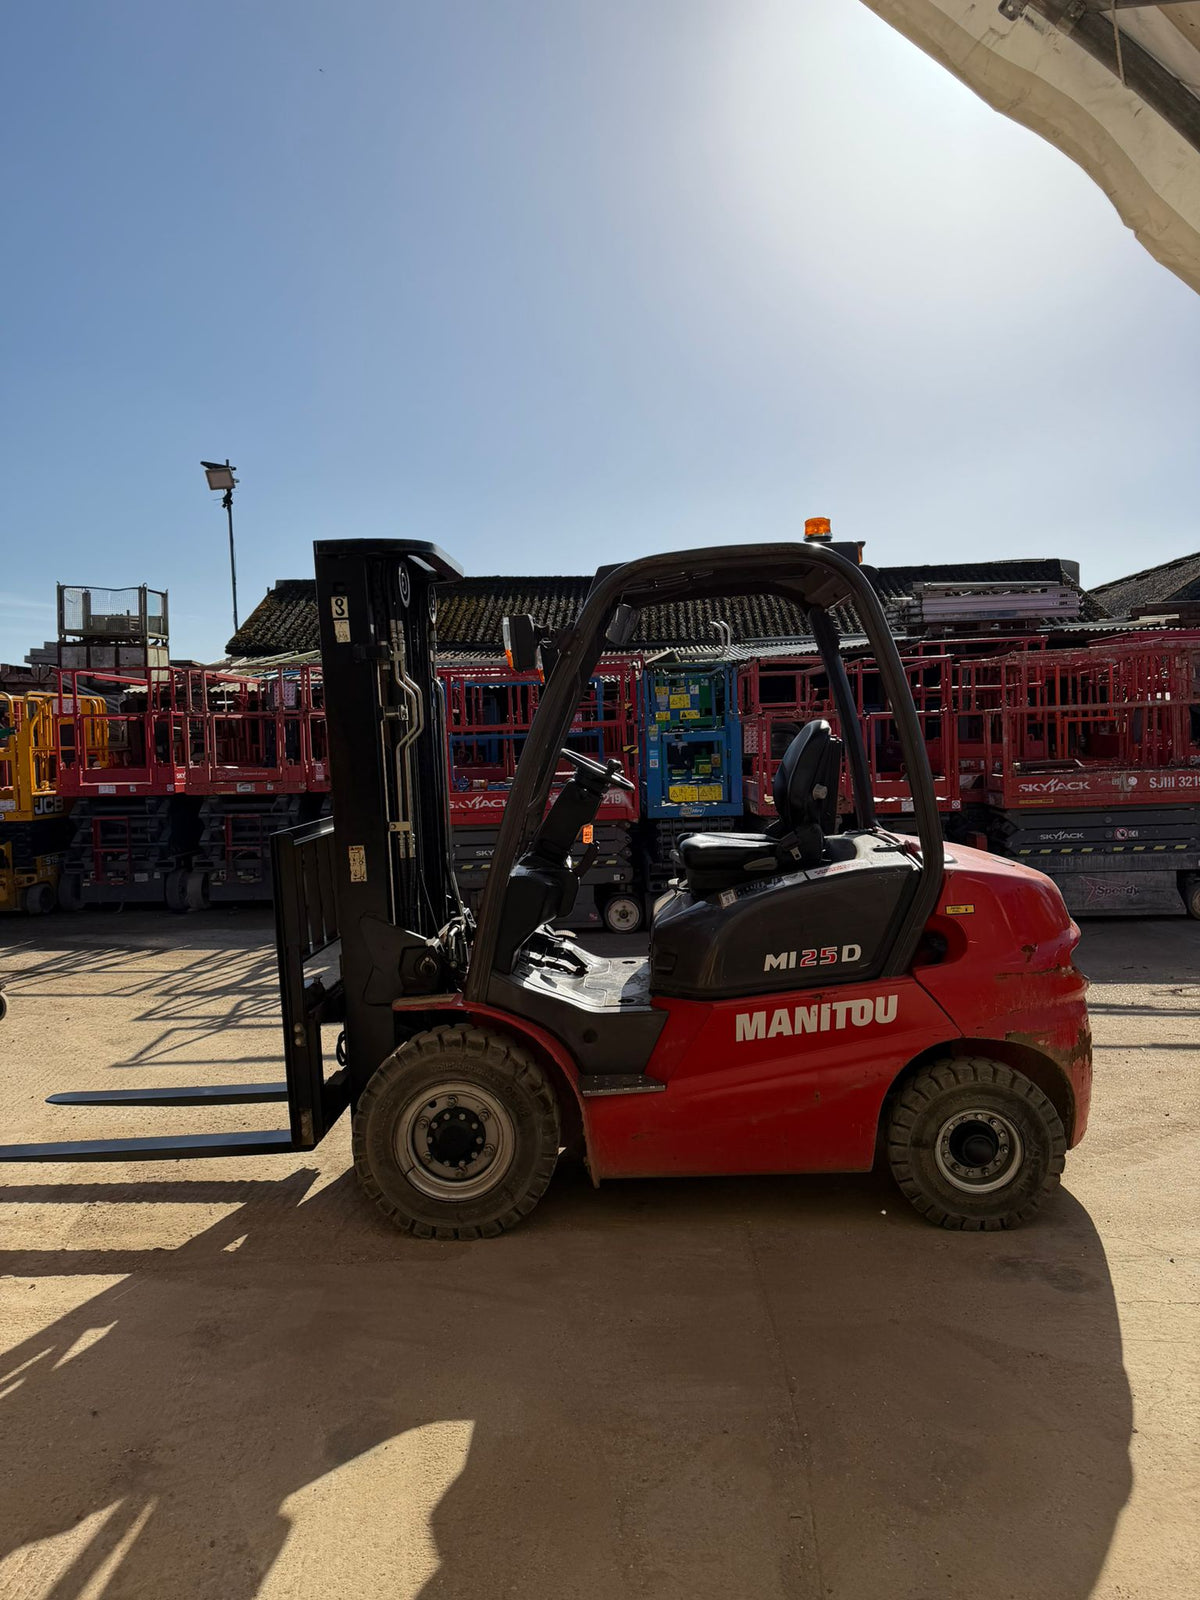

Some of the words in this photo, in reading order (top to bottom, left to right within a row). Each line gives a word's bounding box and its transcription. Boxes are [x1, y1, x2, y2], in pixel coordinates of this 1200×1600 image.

[1018, 778, 1091, 793] SKYJACK
[34, 796, 65, 815] JCB
[600, 793, 621, 804] 219
[1040, 831, 1085, 841] SKYJACK
[735, 994, 899, 1043] MANITOU
